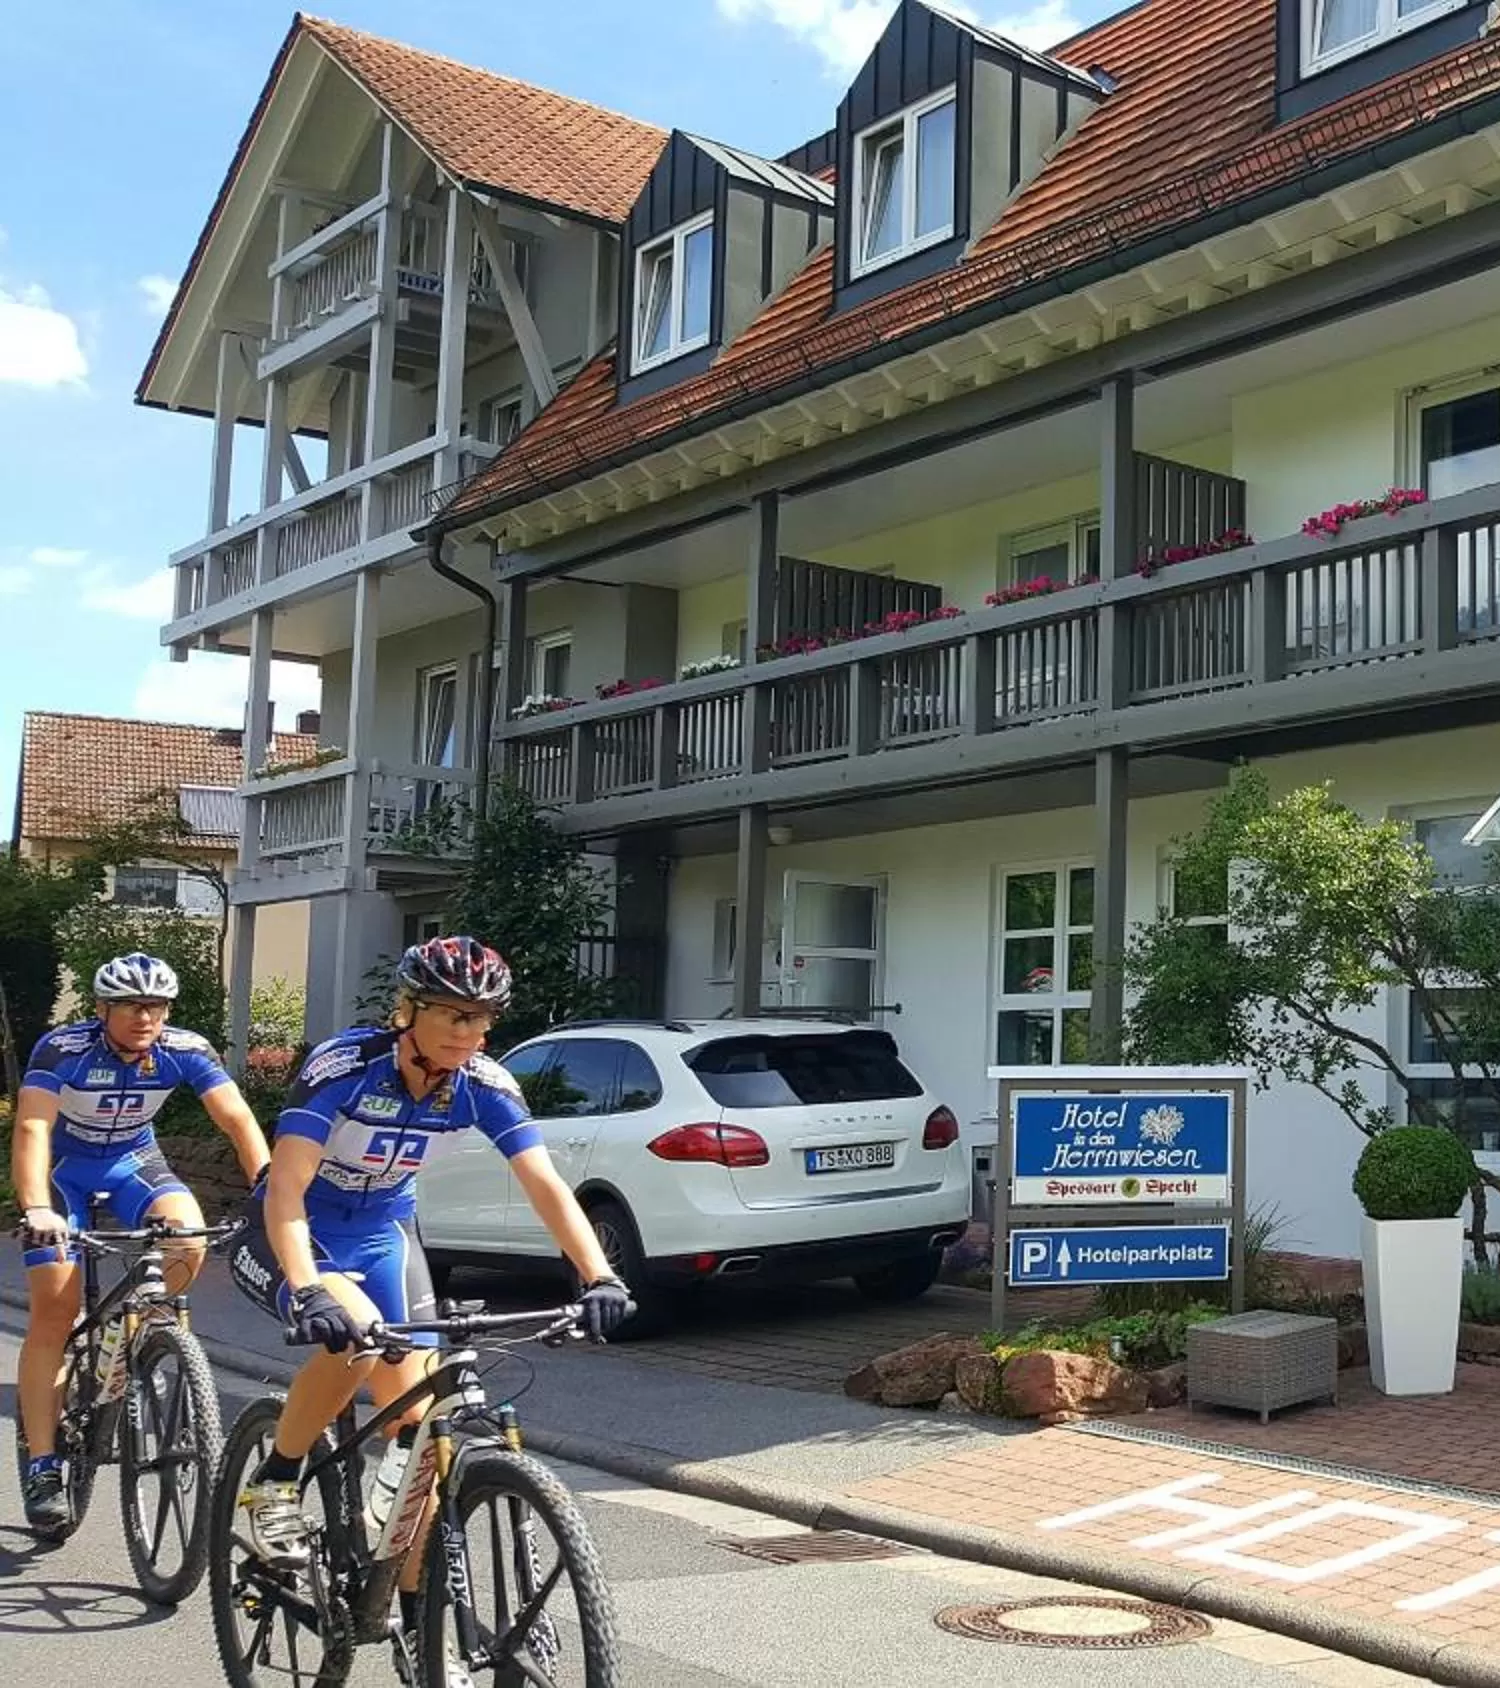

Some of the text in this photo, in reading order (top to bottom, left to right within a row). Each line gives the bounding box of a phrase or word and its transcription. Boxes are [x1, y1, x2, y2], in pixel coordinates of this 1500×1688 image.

[1051, 1101, 1129, 1132] Hotel
[1073, 1130, 1116, 1147] in den
[816, 1151, 835, 1168] TS
[1042, 1143, 1202, 1172] Herrnwiesen
[1046, 1179, 1198, 1197] Spessart Specht
[1023, 1242, 1214, 1273] P Hotelparkplatz
